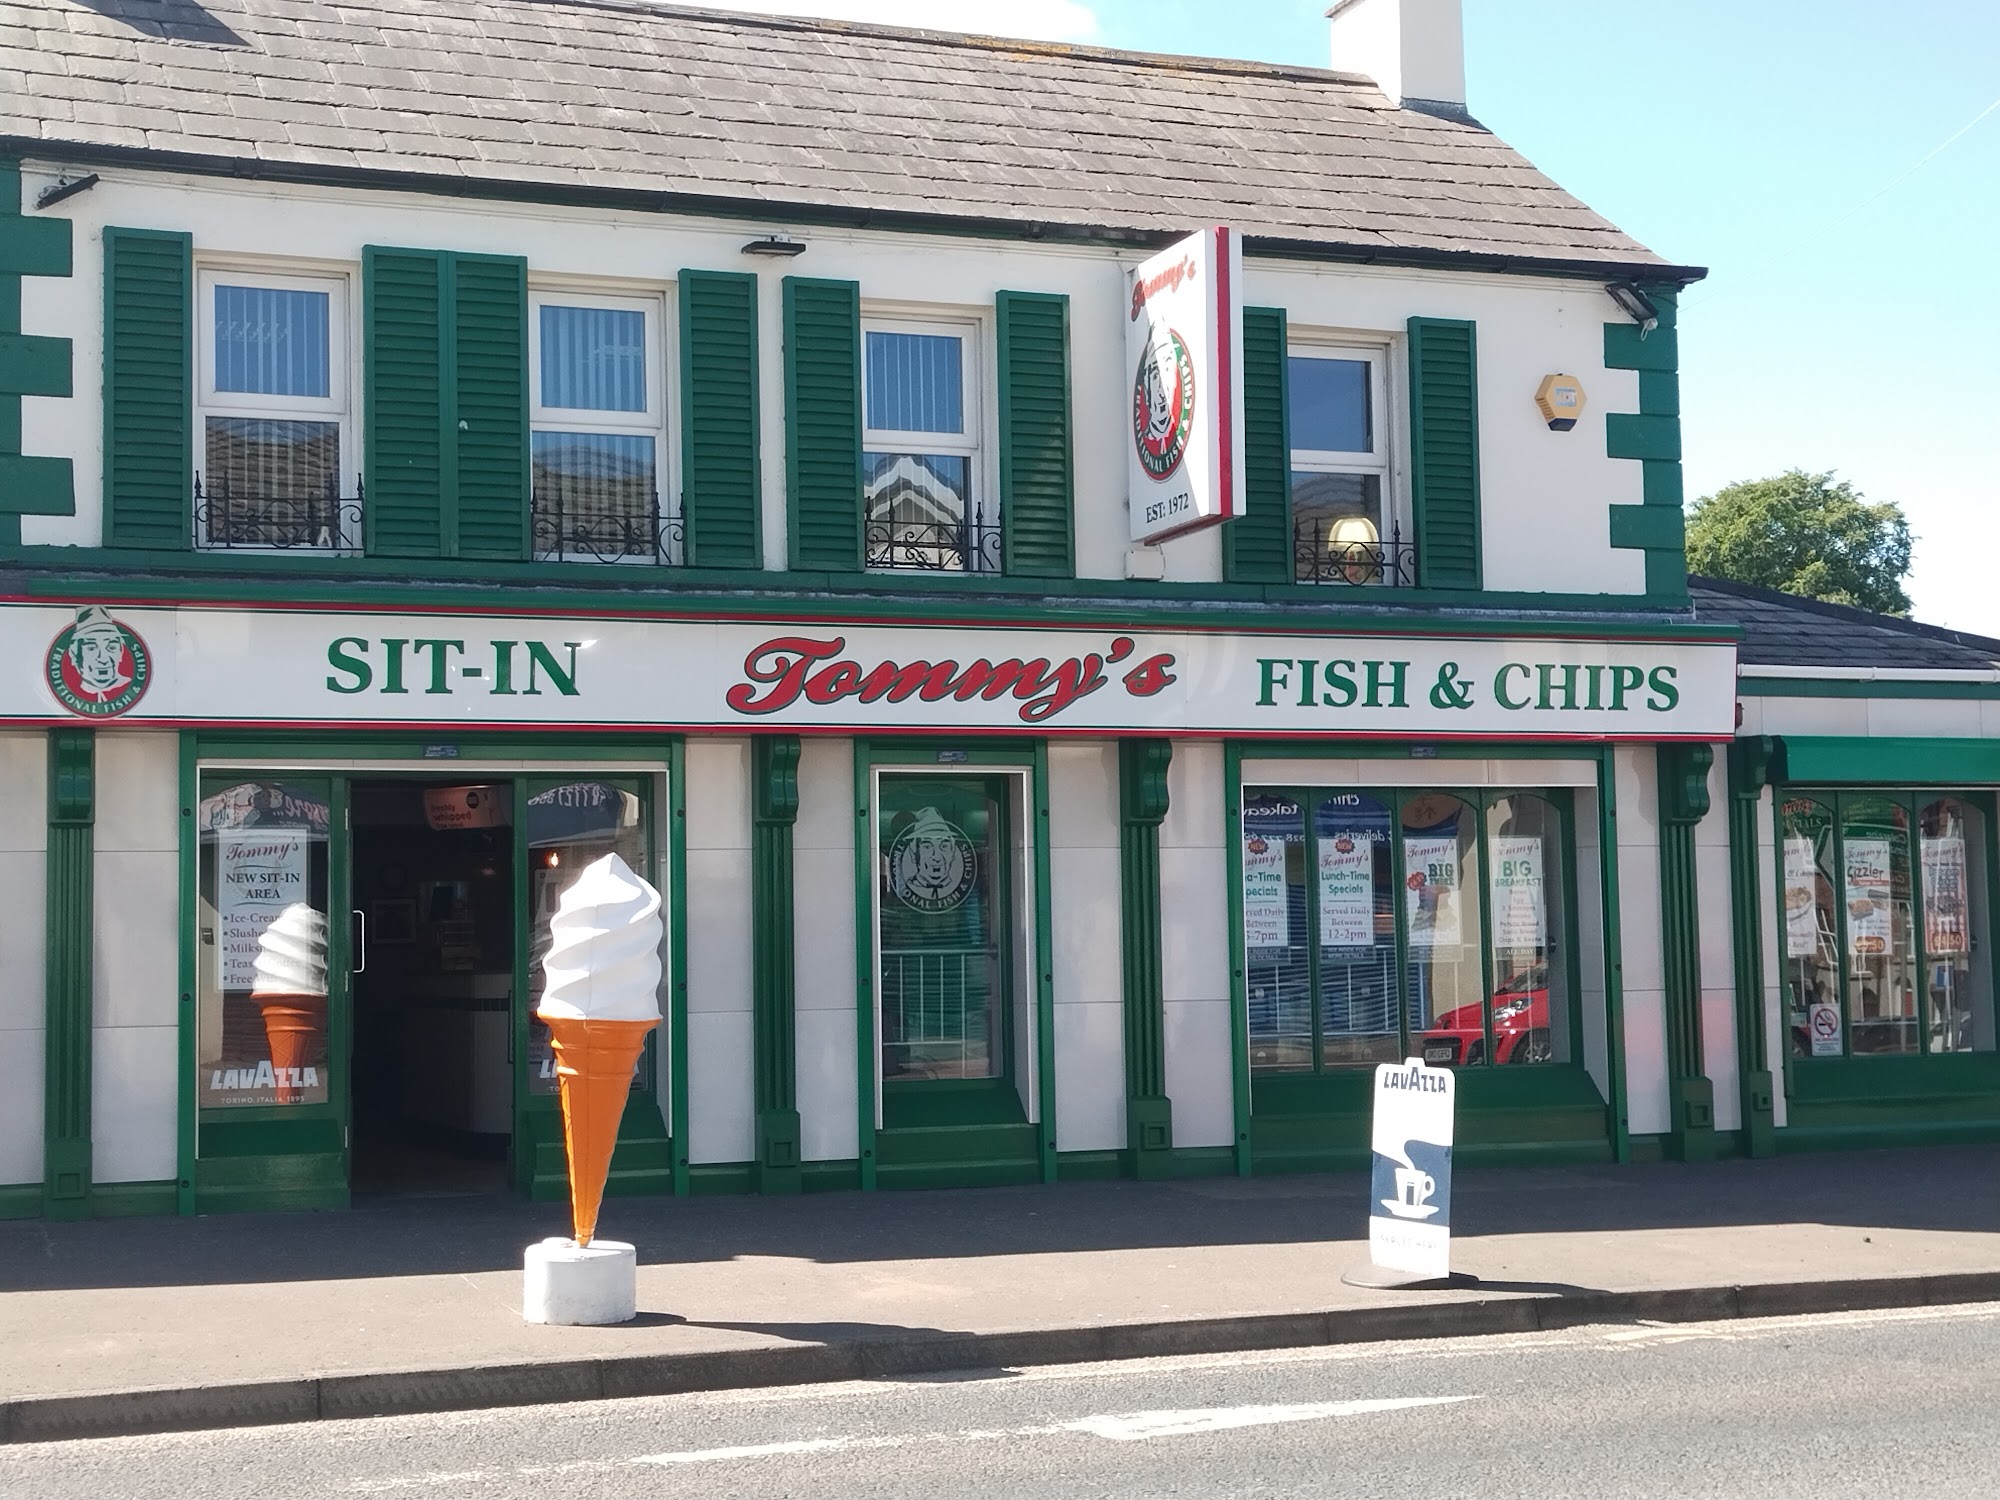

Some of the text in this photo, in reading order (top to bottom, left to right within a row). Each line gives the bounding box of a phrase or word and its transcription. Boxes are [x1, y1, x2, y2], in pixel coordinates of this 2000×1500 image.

[1145, 492, 1190, 524] EST: 1972
[327, 637, 582, 696] SIT-IN
[50, 643, 147, 714] TRADITIONAL FISH & CHIPS
[726, 637, 1177, 722] Tommy's
[1255, 658, 1680, 712] FISH & CHIPS
[226, 837, 299, 860] Tommy's
[1407, 840, 1454, 858] Tommy's
[1320, 849, 1369, 868] Tommy's
[1427, 863, 1454, 877] BIG
[1503, 860, 1532, 877] BIG
[1847, 863, 1884, 884] Sizzler
[226, 872, 300, 884] NEW SIT-IN
[937, 891, 962, 909] FISH
[960, 844, 973, 879] CHIPS
[1321, 871, 1370, 881] Lunch-Time
[1495, 877, 1541, 887] BREAKFAST
[245, 888, 281, 899] AREA
[1246, 886, 1279, 898] pecials
[1329, 884, 1364, 896] Specials
[1264, 908, 1285, 919] Daily
[1323, 906, 1370, 916] Served Daily
[1331, 918, 1363, 927] Between
[1328, 929, 1367, 942] 12-2pm
[230, 959, 253, 969] Teas
[230, 974, 253, 984] Free
[210, 1060, 319, 1090] LAVAZZA
[1383, 1066, 1447, 1093] LAVAZZA
[287, 1095, 305, 1103] 1895
